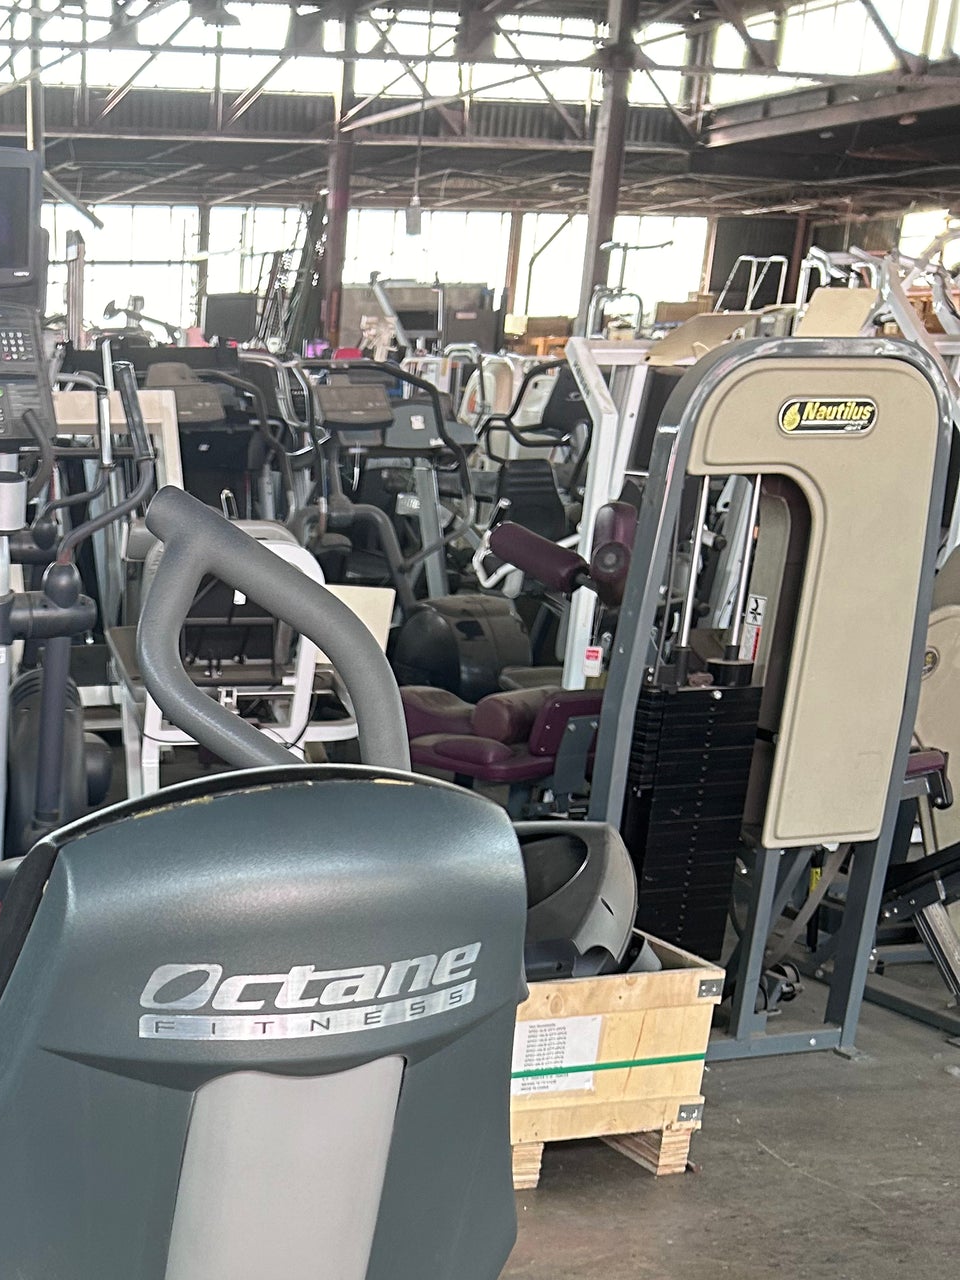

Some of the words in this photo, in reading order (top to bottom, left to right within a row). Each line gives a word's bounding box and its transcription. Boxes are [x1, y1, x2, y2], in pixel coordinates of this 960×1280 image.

[802, 401, 874, 421] Nautilus
[139, 942, 482, 1011] Octane
[152, 989, 464, 1035] FITNESS
